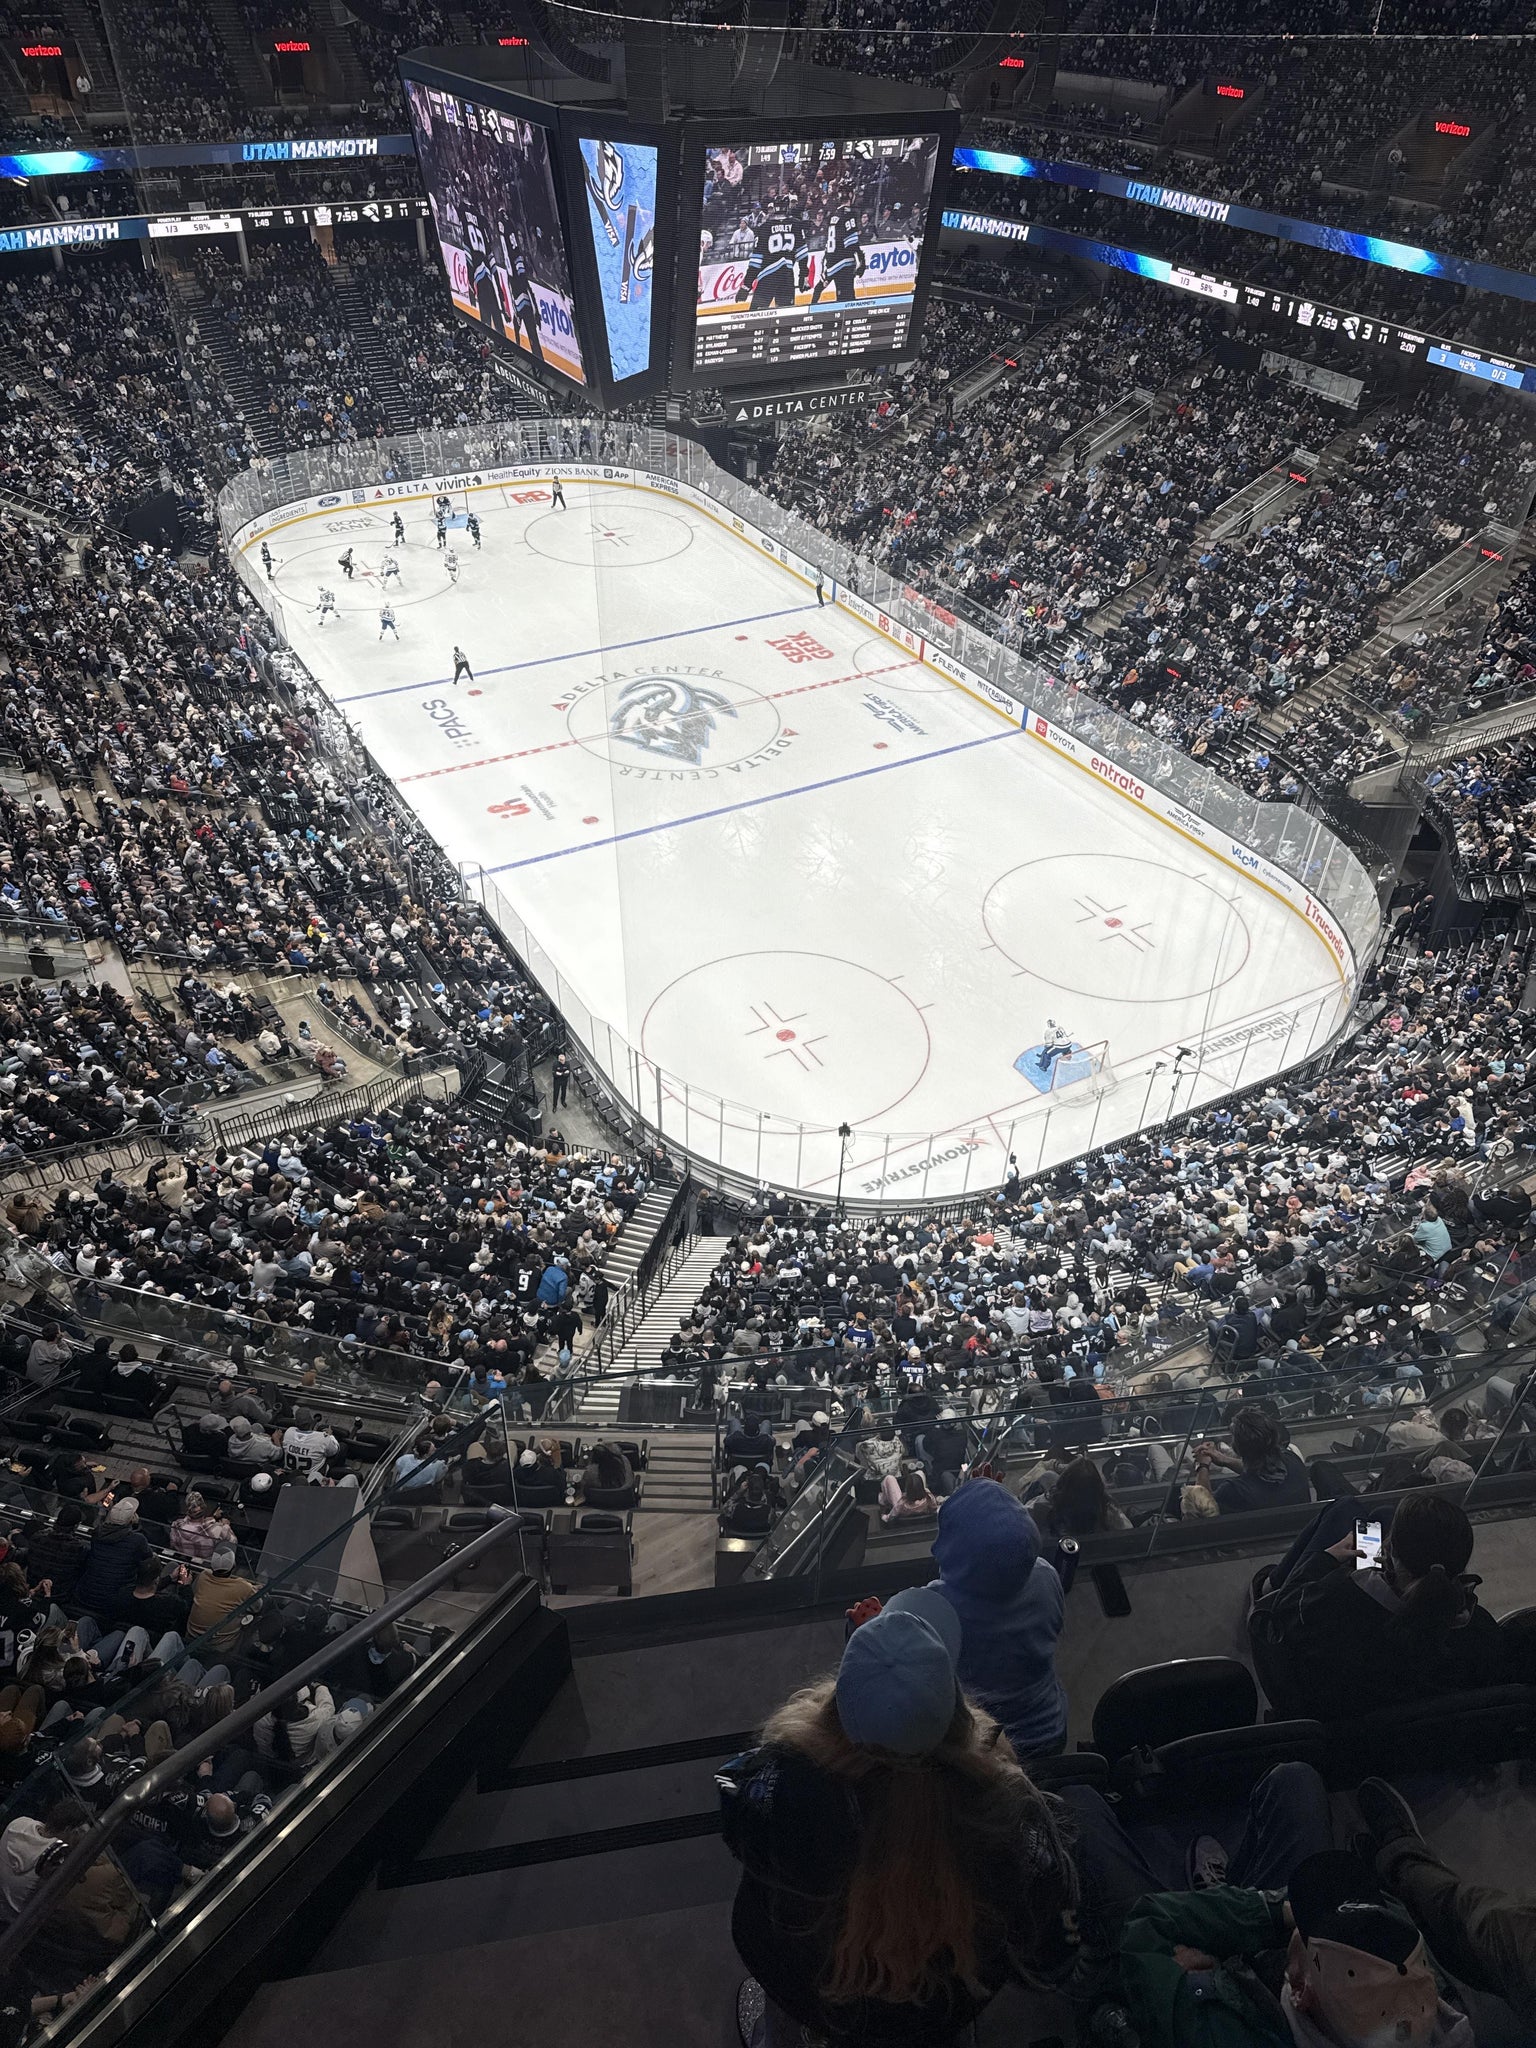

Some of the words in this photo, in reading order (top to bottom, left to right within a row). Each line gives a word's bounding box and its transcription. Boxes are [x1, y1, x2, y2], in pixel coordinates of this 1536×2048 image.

[21, 45, 62, 57] verizon
[274, 40, 311, 53] verizon
[999, 57, 1024, 68] rizon
[1217, 85, 1244, 98] verizon
[1435, 121, 1470, 136] verizon
[242, 143, 289, 161] UTAH
[291, 138, 378, 160] MAMMOTH
[822, 142, 835, 150] 2ND
[845, 142, 853, 153] 3
[818, 149, 836, 161] 7:59
[1126, 182, 1160, 204] UTAH
[1159, 189, 1231, 222] MAMMOTH
[302, 210, 309, 224] 1
[335, 210, 359, 222] 7:59
[383, 205, 393, 218] 3
[399, 209, 409, 217] 11
[193, 223, 211, 232] 58%
[224, 222, 230, 230] 9
[254, 219, 270, 228] 1:49
[284, 217, 294, 225] 10
[959, 215, 1030, 241] MAMMOTH
[25, 222, 120, 248] MAMMOTH
[165, 225, 178, 233] 1/3
[604, 219, 618, 245] VISA
[771, 224, 793, 234] COOLEY
[713, 265, 744, 299] Coc
[1180, 276, 1190, 286] 1/3
[620, 280, 629, 301] VISA
[1271, 302, 1281, 312] 10
[1287, 301, 1294, 317] 1
[1316, 315, 1339, 331] 7:59
[1361, 323, 1373, 340] 3
[1378, 333, 1388, 344] 11
[1399, 341, 1416, 354] 2:00
[1439, 354, 1446, 363] 3
[1458, 358, 1477, 372] 42%
[1491, 368, 1507, 381] 0/3
[500, 366, 522, 388] DELTA
[521, 381, 548, 406] CENTER
[752, 400, 805, 418] DELTA
[809, 391, 866, 410] CENTER
[487, 467, 543, 481] HealthEquity
[544, 467, 573, 477] ZIONS
[574, 467, 600, 477] BANK
[435, 475, 472, 492] vivint
[645, 473, 679, 488] AMERICAN
[387, 484, 430, 497] DELTA
[650, 481, 679, 495] EXPRESS
[271, 507, 306, 524] INGREDIENTS
[322, 516, 374, 529] ZIONS
[328, 522, 378, 534] BANK
[764, 638, 813, 664] SEAT
[785, 630, 835, 660] GEEK
[938, 656, 967, 682] FILEVINE
[560, 671, 627, 701] DELTA
[634, 665, 724, 678] CENTER
[421, 698, 473, 740] PACS
[1049, 729, 1076, 753] TOYOTA
[726, 739, 793, 774] DELTA
[618, 766, 720, 781] CENTER
[1090, 757, 1145, 801] entrata
[1312, 904, 1345, 961] Trucordia
[860, 1141, 980, 1194] CROWDSTRIKE
[518, 1274, 530, 1292] 9
[1071, 1339, 1091, 1358] 57
[288, 1444, 311, 1457] COOLEY
